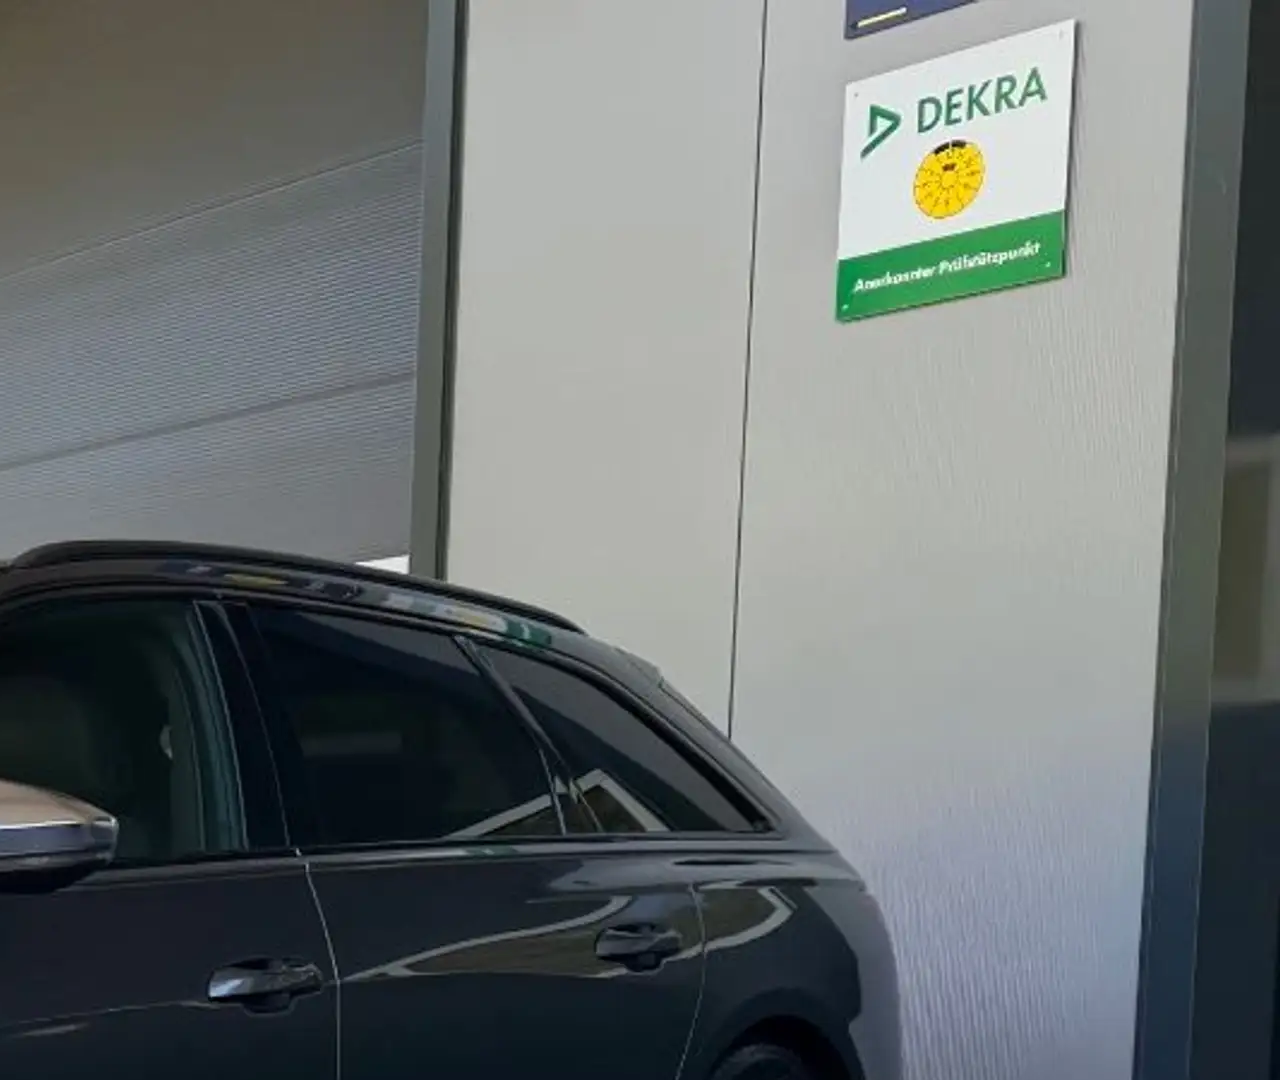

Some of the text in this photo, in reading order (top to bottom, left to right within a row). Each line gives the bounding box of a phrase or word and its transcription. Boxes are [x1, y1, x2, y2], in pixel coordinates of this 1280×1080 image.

[916, 68, 1047, 134] DEKRA
[853, 240, 1041, 293] Anerkannter Prüfstützpunkt
